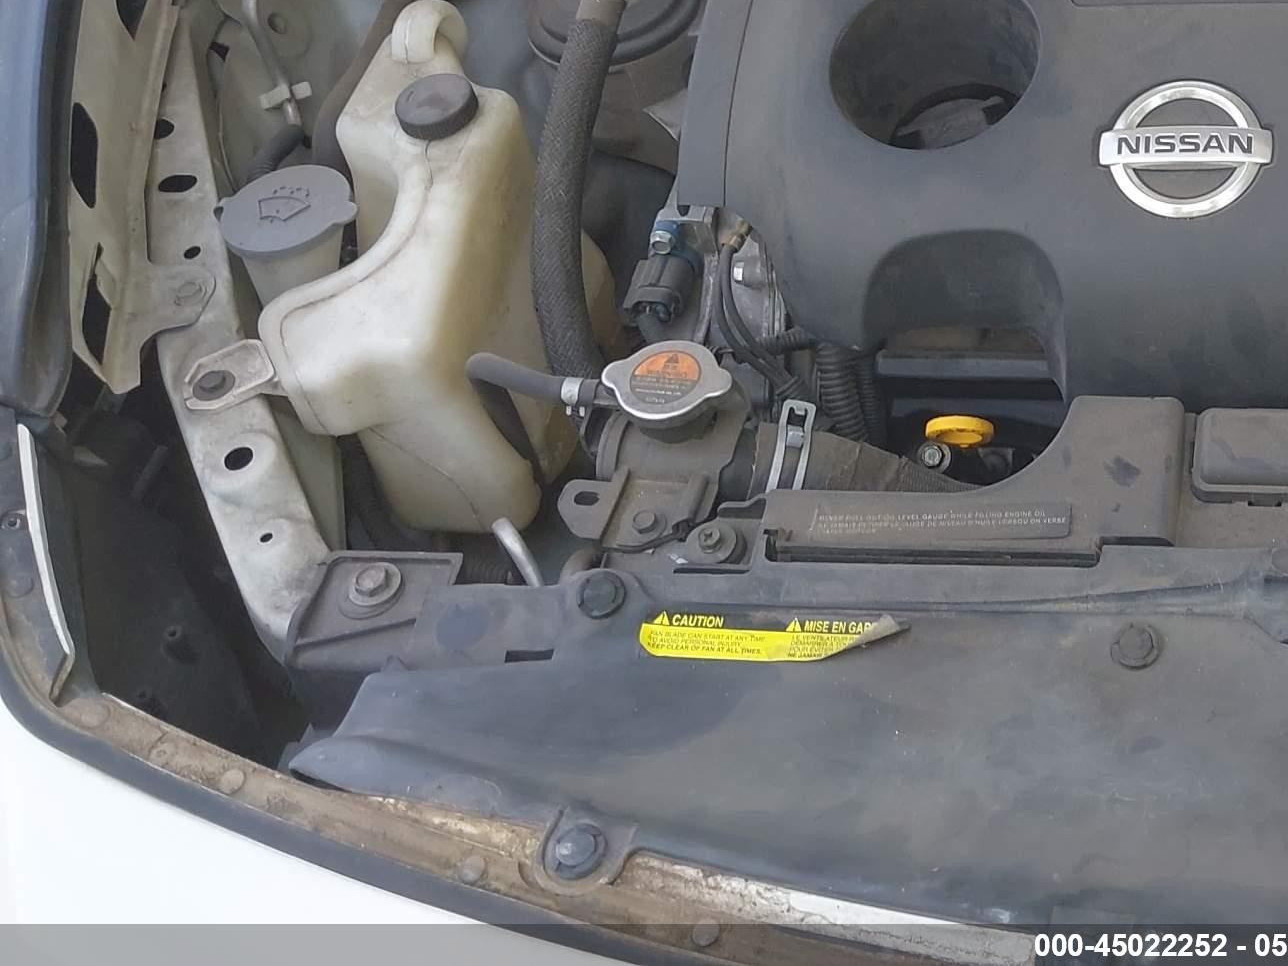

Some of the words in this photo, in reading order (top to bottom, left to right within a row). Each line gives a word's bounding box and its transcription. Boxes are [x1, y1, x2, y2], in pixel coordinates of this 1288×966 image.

[1116, 133, 1255, 155] NISSAN
[671, 613, 725, 628] CAUTION
[803, 619, 830, 632] MISE
[831, 621, 847, 633] EN
[666, 643, 689, 651] CLEAR
